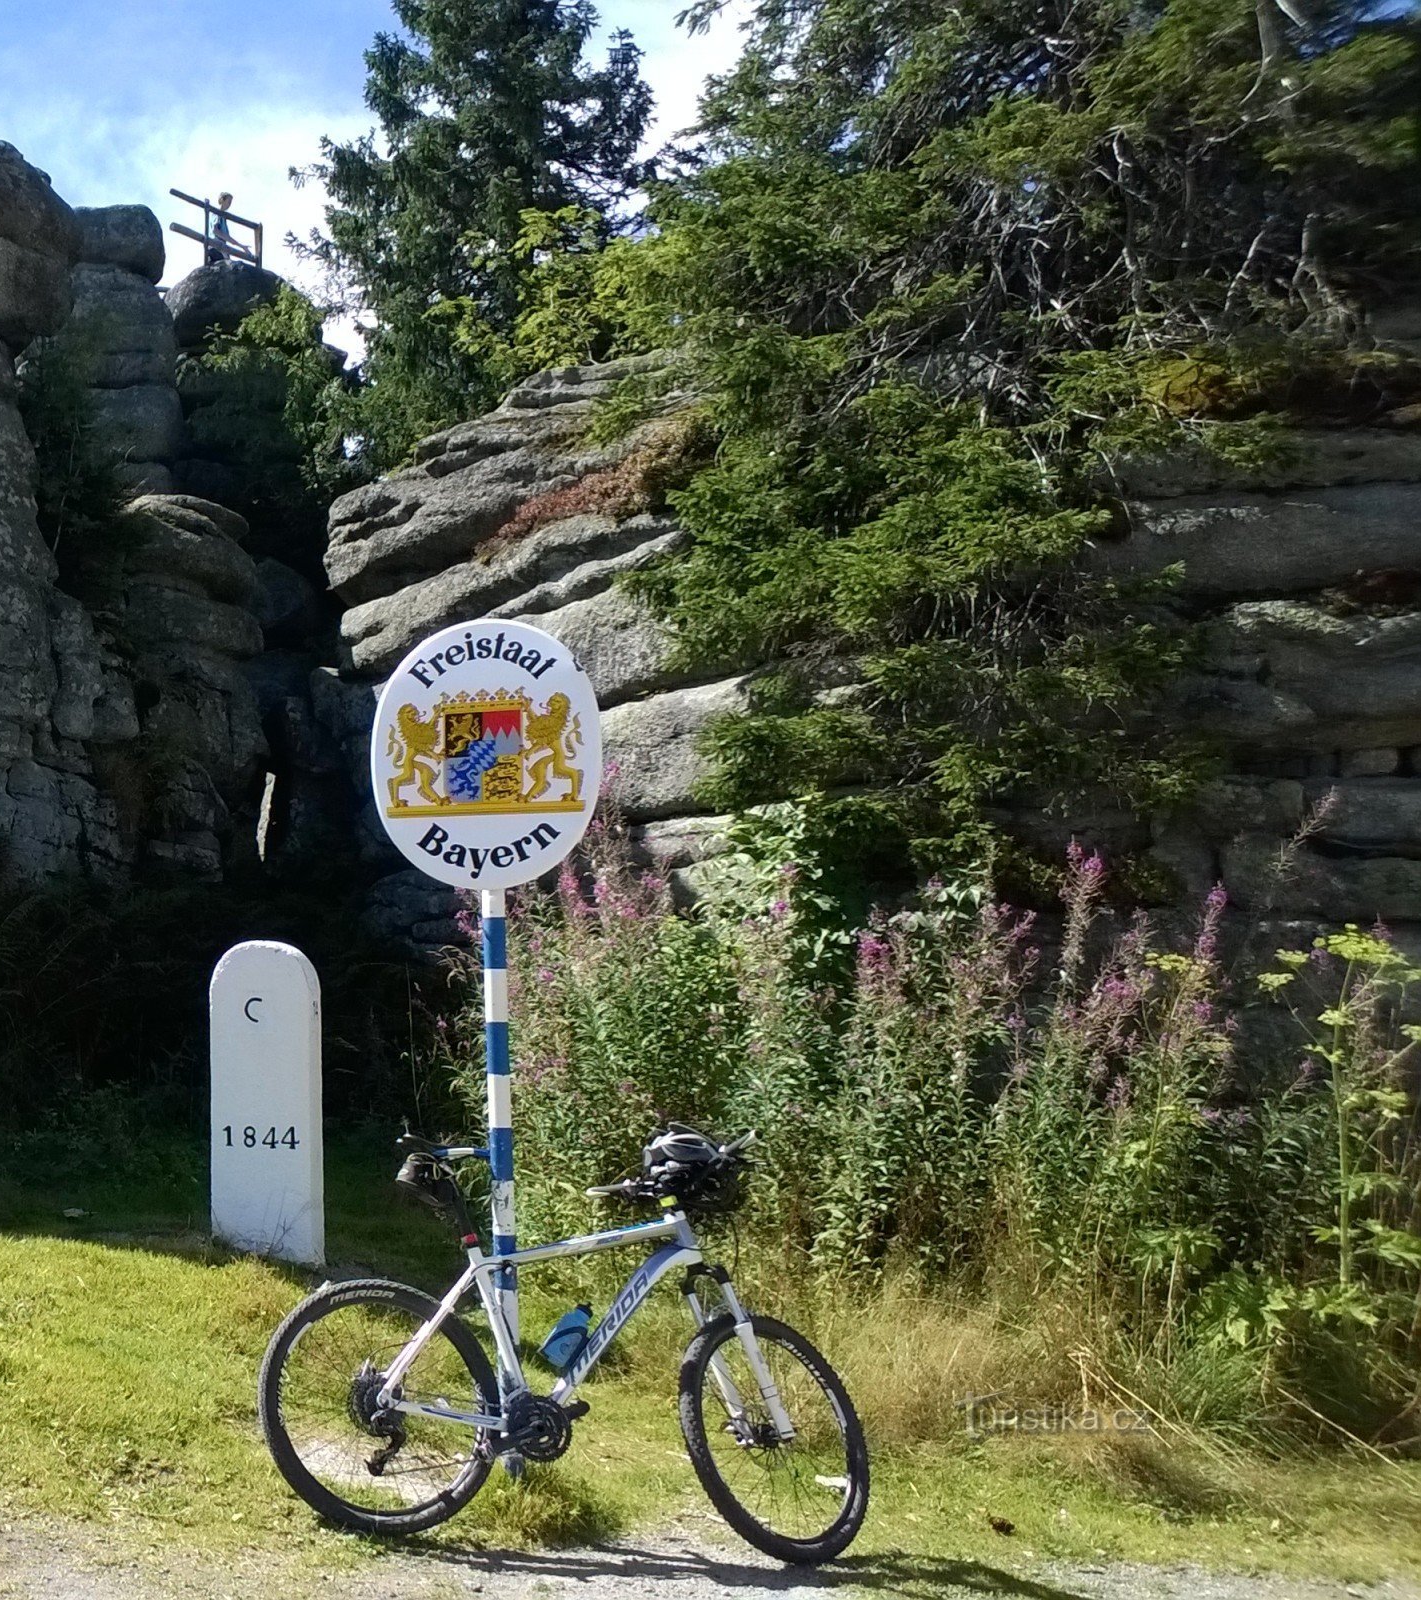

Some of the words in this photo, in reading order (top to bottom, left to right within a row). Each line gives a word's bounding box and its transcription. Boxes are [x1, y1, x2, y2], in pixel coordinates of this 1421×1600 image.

[408, 632, 557, 689] Freistaat
[416, 823, 561, 879] Bayern
[244, 997, 262, 1022] C
[222, 1125, 300, 1150] 1844
[330, 1290, 396, 1305] MERIDA
[569, 1272, 648, 1383] MERIDA
